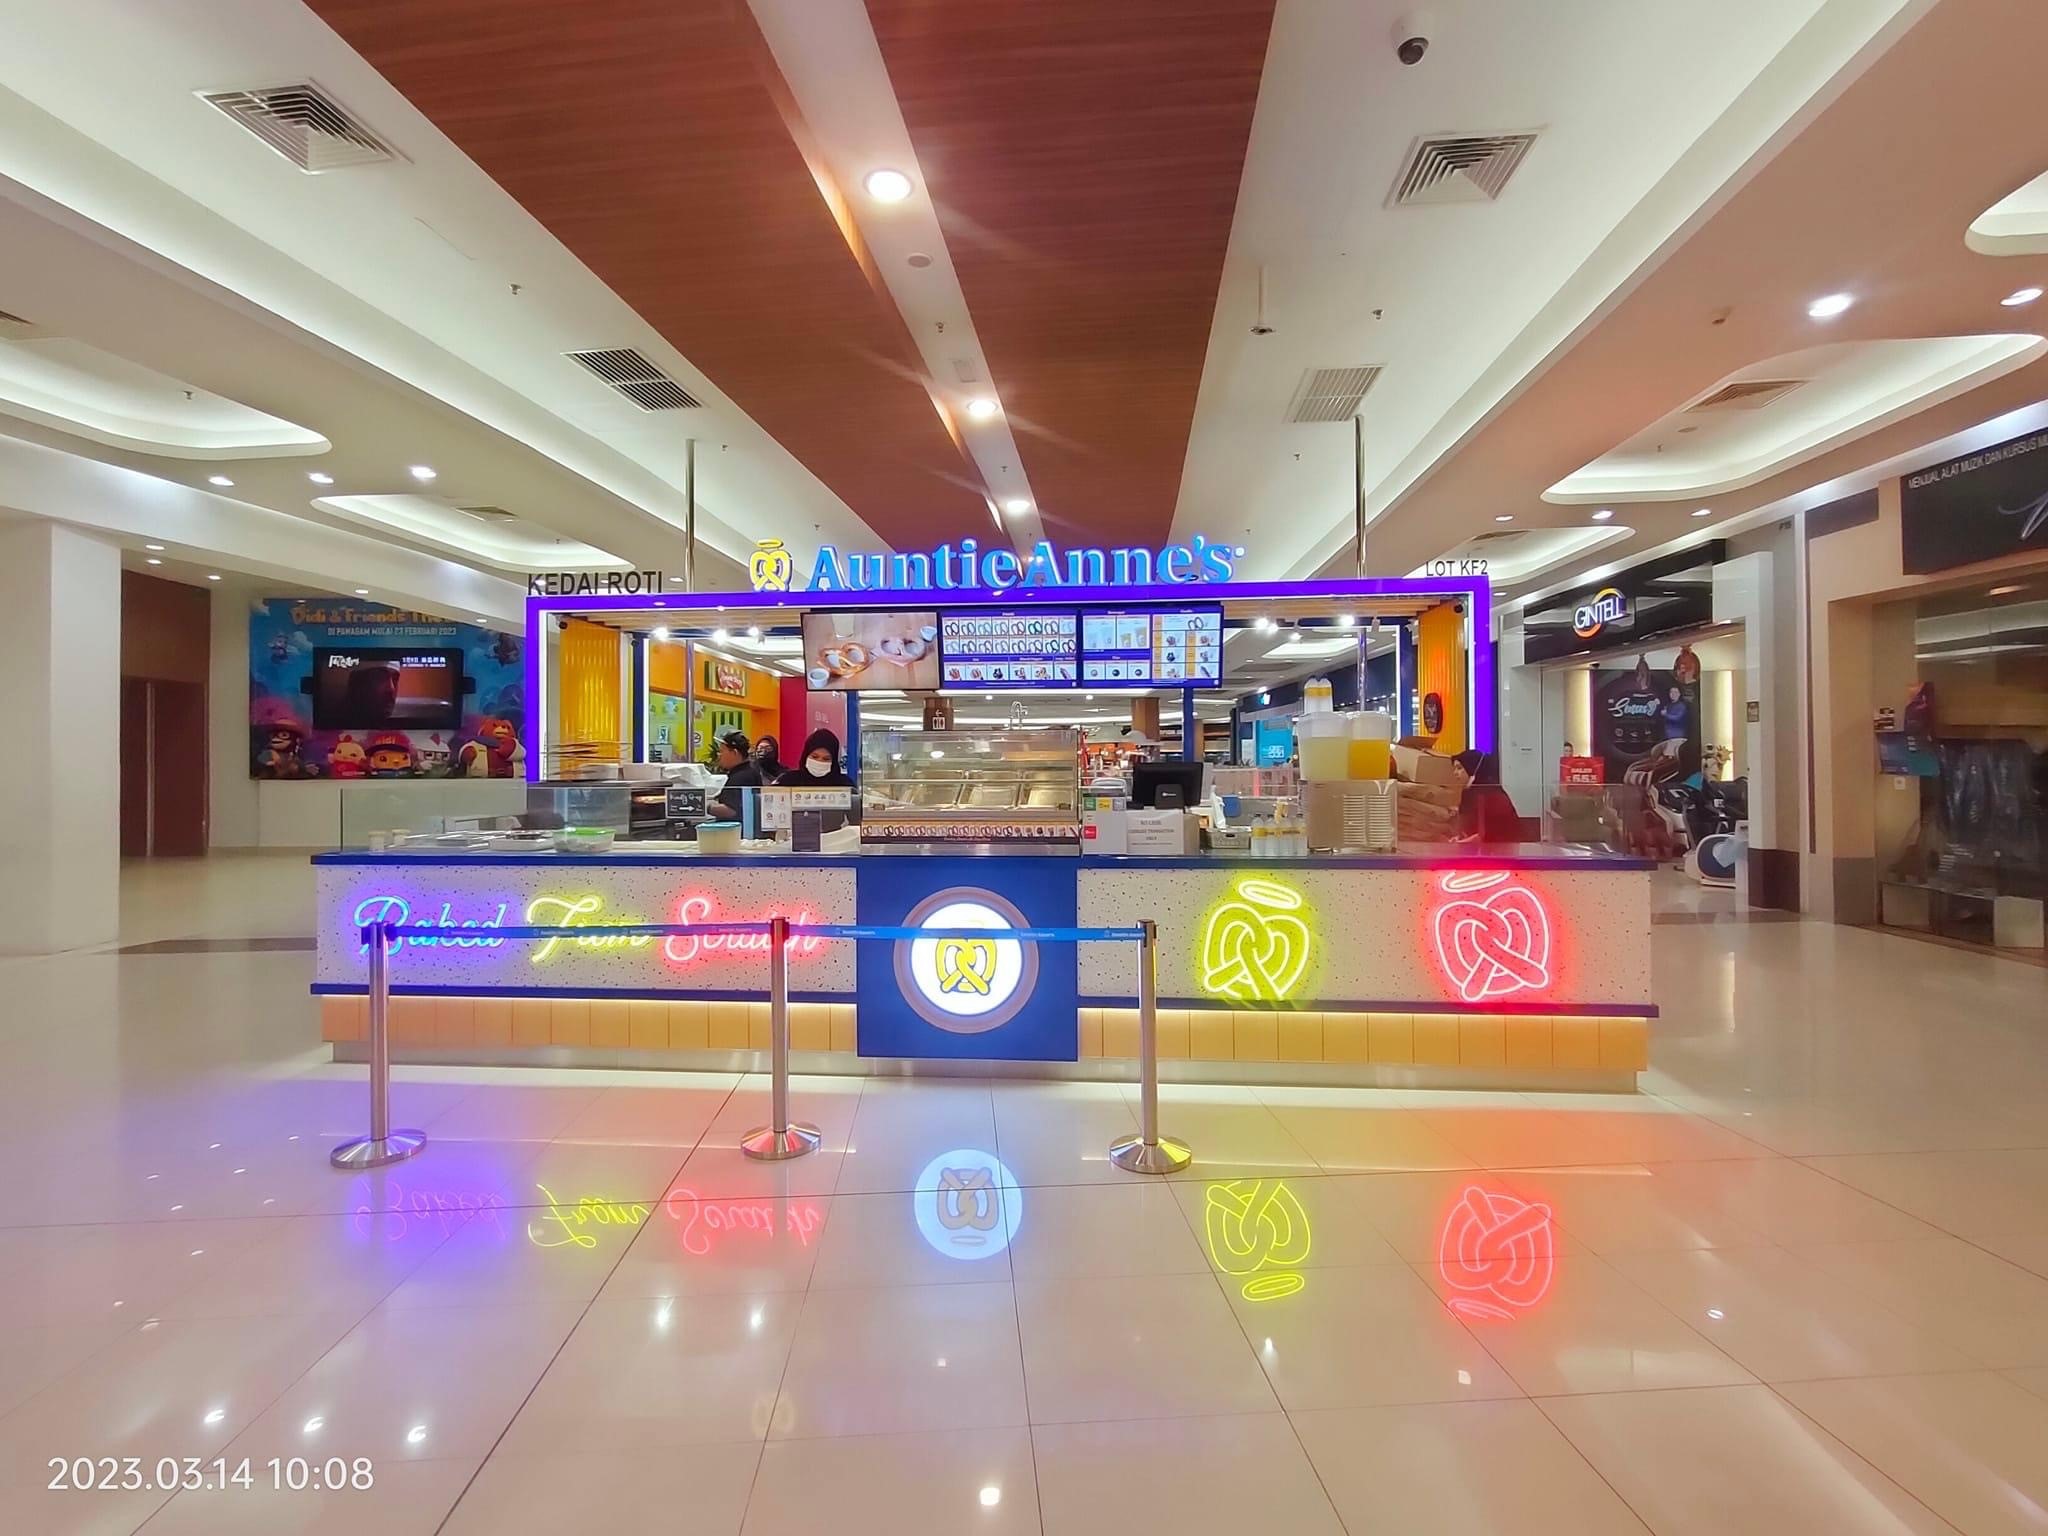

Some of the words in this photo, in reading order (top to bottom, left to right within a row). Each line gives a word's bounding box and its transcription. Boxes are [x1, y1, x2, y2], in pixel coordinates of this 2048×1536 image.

[1941, 463, 1960, 480] ALAT
[1984, 451, 2002, 465] DAN
[804, 536, 1019, 592] Auntie
[1018, 534, 1236, 590] Anne's
[1425, 560, 1455, 577] LOT
[1460, 559, 1488, 576] KF2
[527, 572, 599, 596] KEDAI
[607, 570, 663, 594] ROTI
[1574, 596, 1625, 630] GINTELL
[664, 897, 820, 961] Scrath
